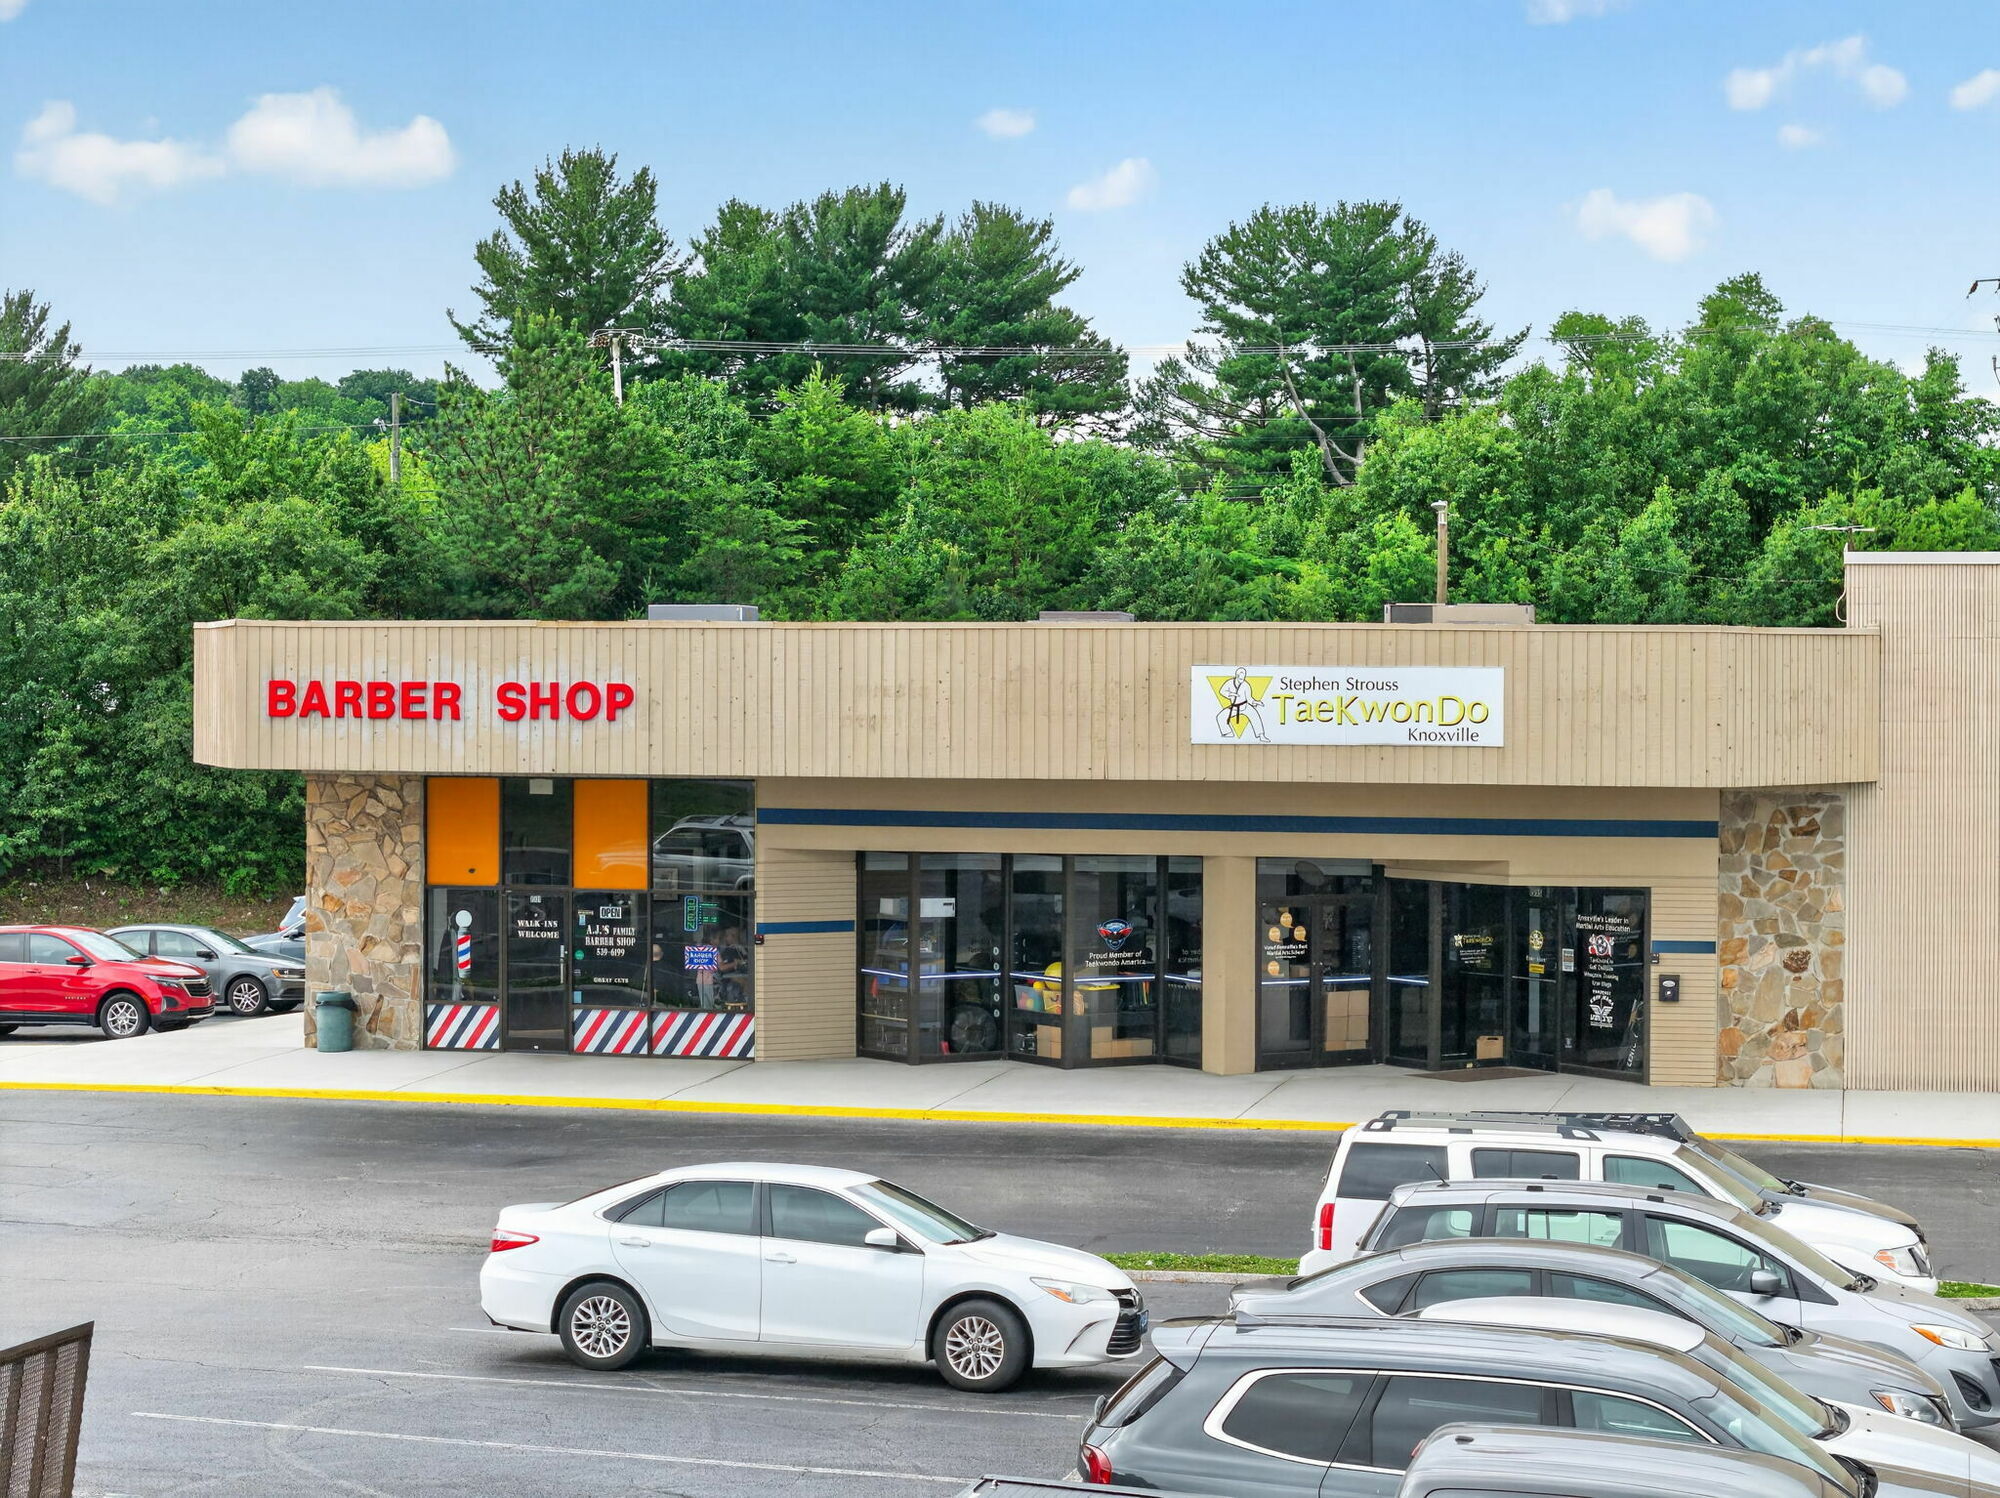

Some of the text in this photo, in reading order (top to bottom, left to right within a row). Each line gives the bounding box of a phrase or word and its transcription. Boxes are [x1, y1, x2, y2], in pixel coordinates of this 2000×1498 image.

[1280, 676, 1399, 693] Stephen Strouss
[267, 680, 634, 721] BARBER SHOP
[1272, 694, 1489, 726] TaeKwonDo
[1408, 728, 1480, 742] Knoxville
[601, 908, 621, 918] OPEN
[517, 920, 558, 928] WALK-INS
[518, 930, 560, 939] WELCOME
[612, 927, 636, 936] FAMILY
[585, 936, 636, 946] BARBER SHOP
[1108, 950, 1134, 958] Member
[1085, 958, 1146, 968] Taekwondo America
